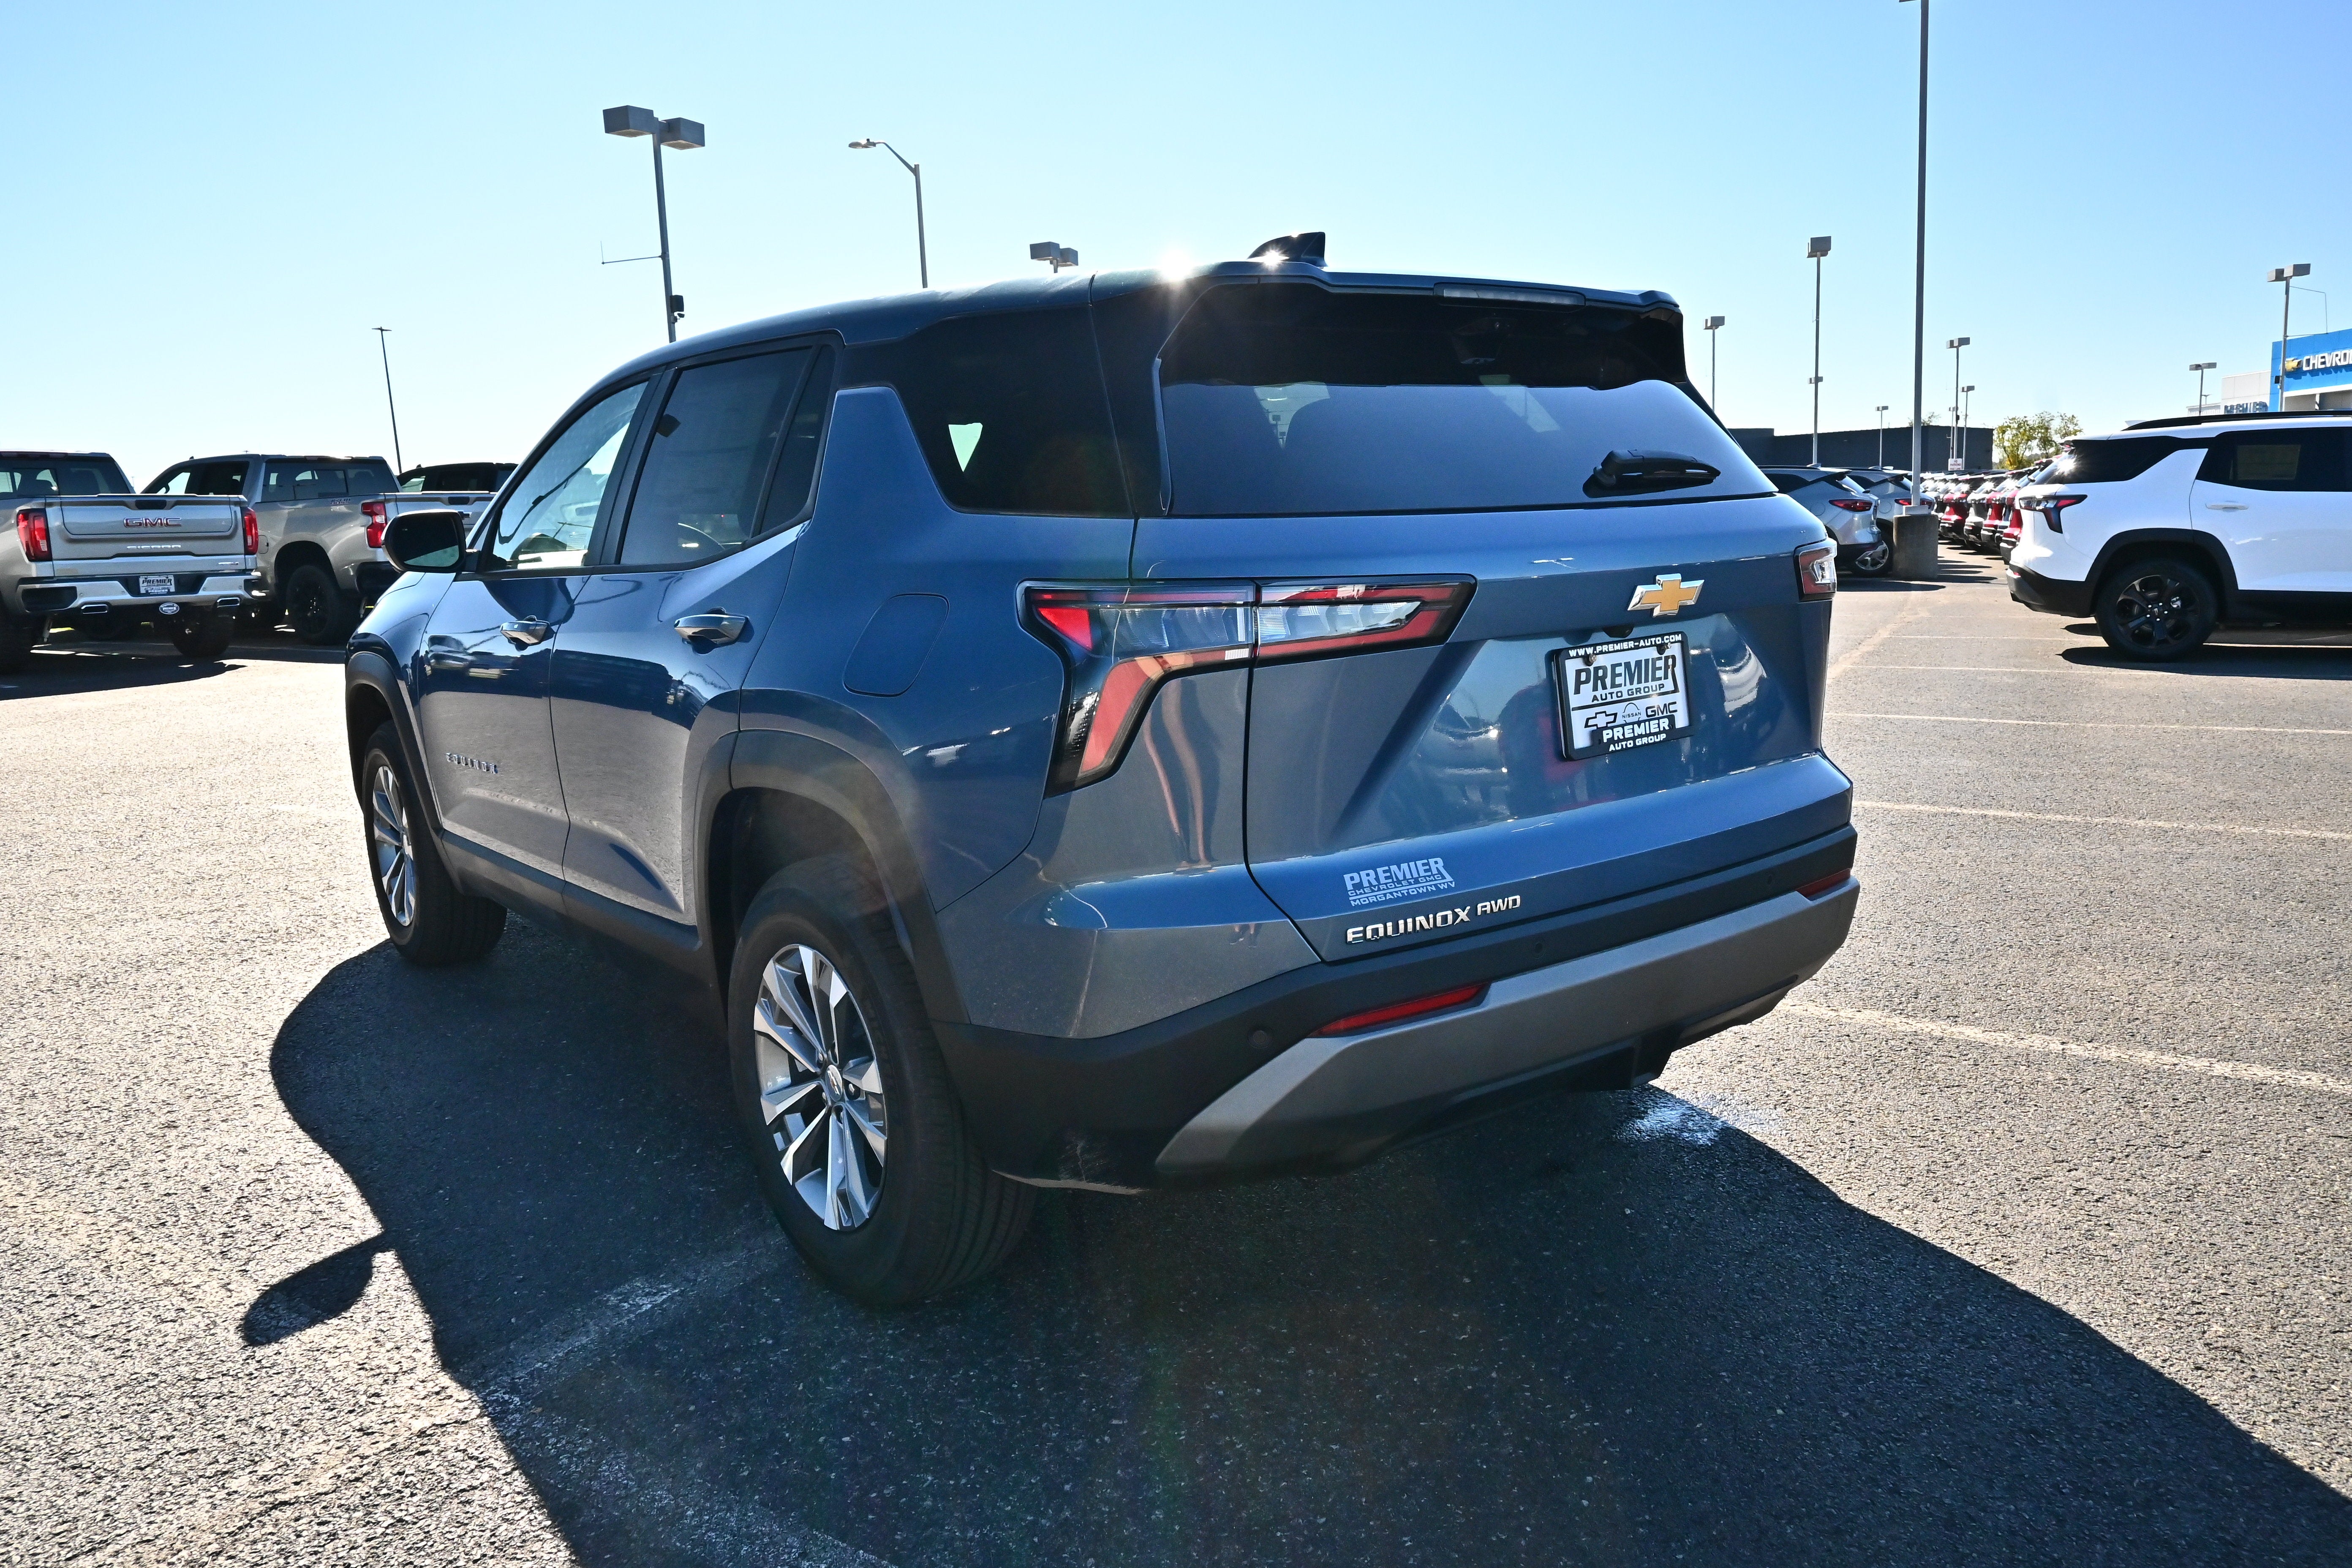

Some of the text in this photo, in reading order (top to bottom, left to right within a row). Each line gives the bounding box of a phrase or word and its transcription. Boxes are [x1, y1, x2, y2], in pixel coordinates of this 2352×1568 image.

[124, 517, 182, 528] GMC
[1568, 634, 1682, 657] WWW.PREMIER-AUTO.COM
[1573, 654, 1680, 695] PREMIER
[1591, 683, 1665, 702] AUTO GROUP
[1645, 701, 1678, 718] GMC
[1602, 718, 1669, 743] PREMIER
[1609, 733, 1666, 751] AUTO GROUP
[1343, 857, 1454, 890] PREMIER
[1348, 875, 1442, 896] CHEVROLET GMC
[1350, 881, 1455, 906] MORGANTOWN WV
[1346, 895, 1521, 944] EQUINOX AWD
